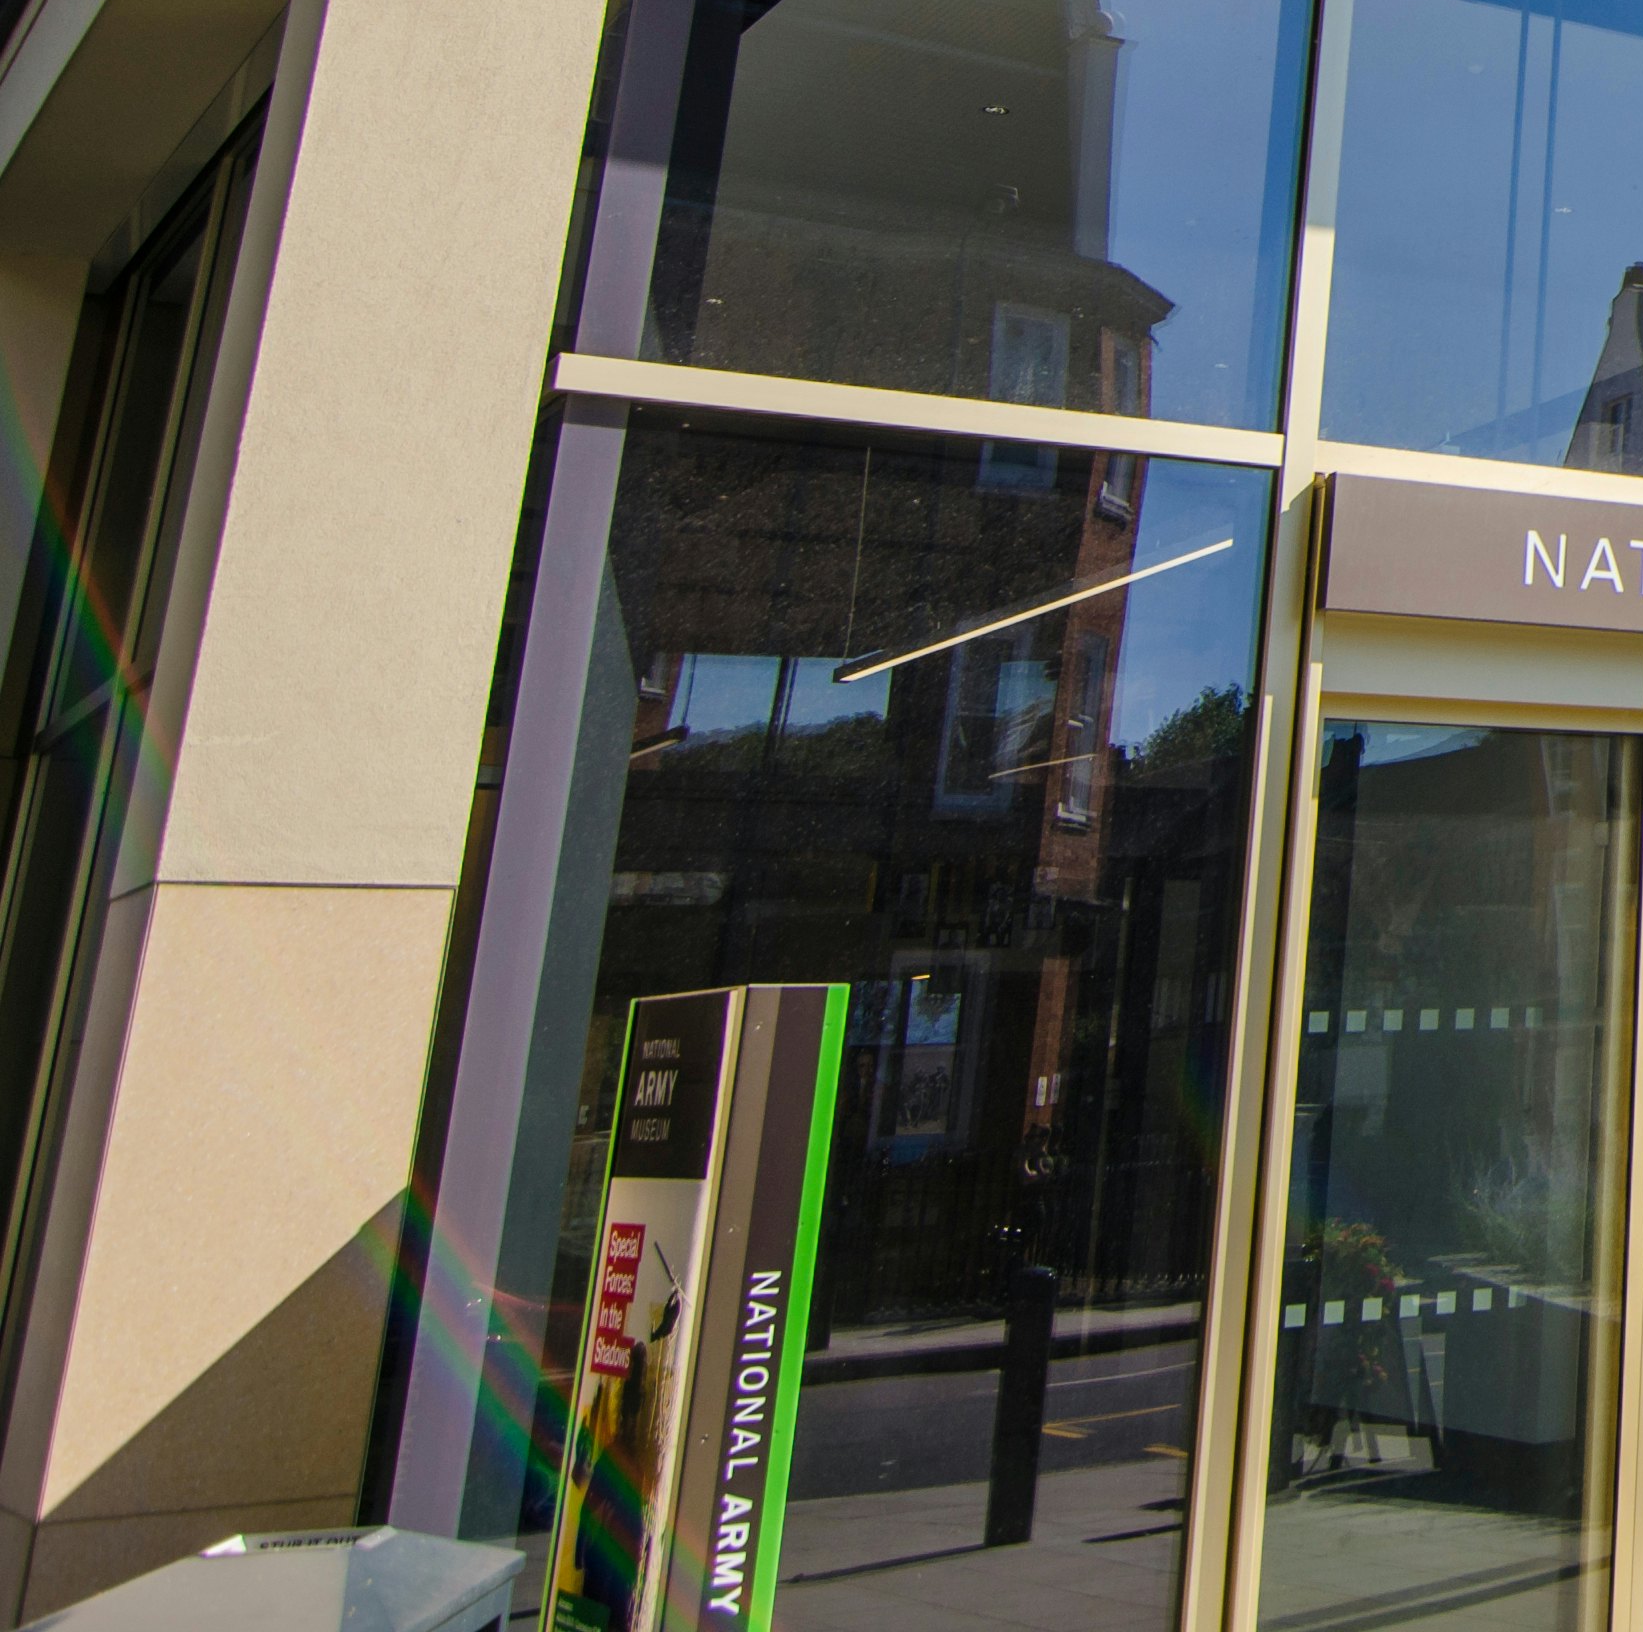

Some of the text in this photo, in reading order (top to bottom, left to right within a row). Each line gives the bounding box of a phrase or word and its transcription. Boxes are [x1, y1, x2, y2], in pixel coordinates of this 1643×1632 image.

[642, 1038, 681, 1060] NATIONAL
[634, 1069, 679, 1107] ARMY
[630, 1117, 671, 1142] MUSEUM
[609, 1230, 641, 1264] Special
[604, 1265, 635, 1295] Forces:
[600, 1301, 623, 1330] In the
[594, 1336, 631, 1369] Shadows
[709, 1270, 782, 1617] NATIONAL ARMY
